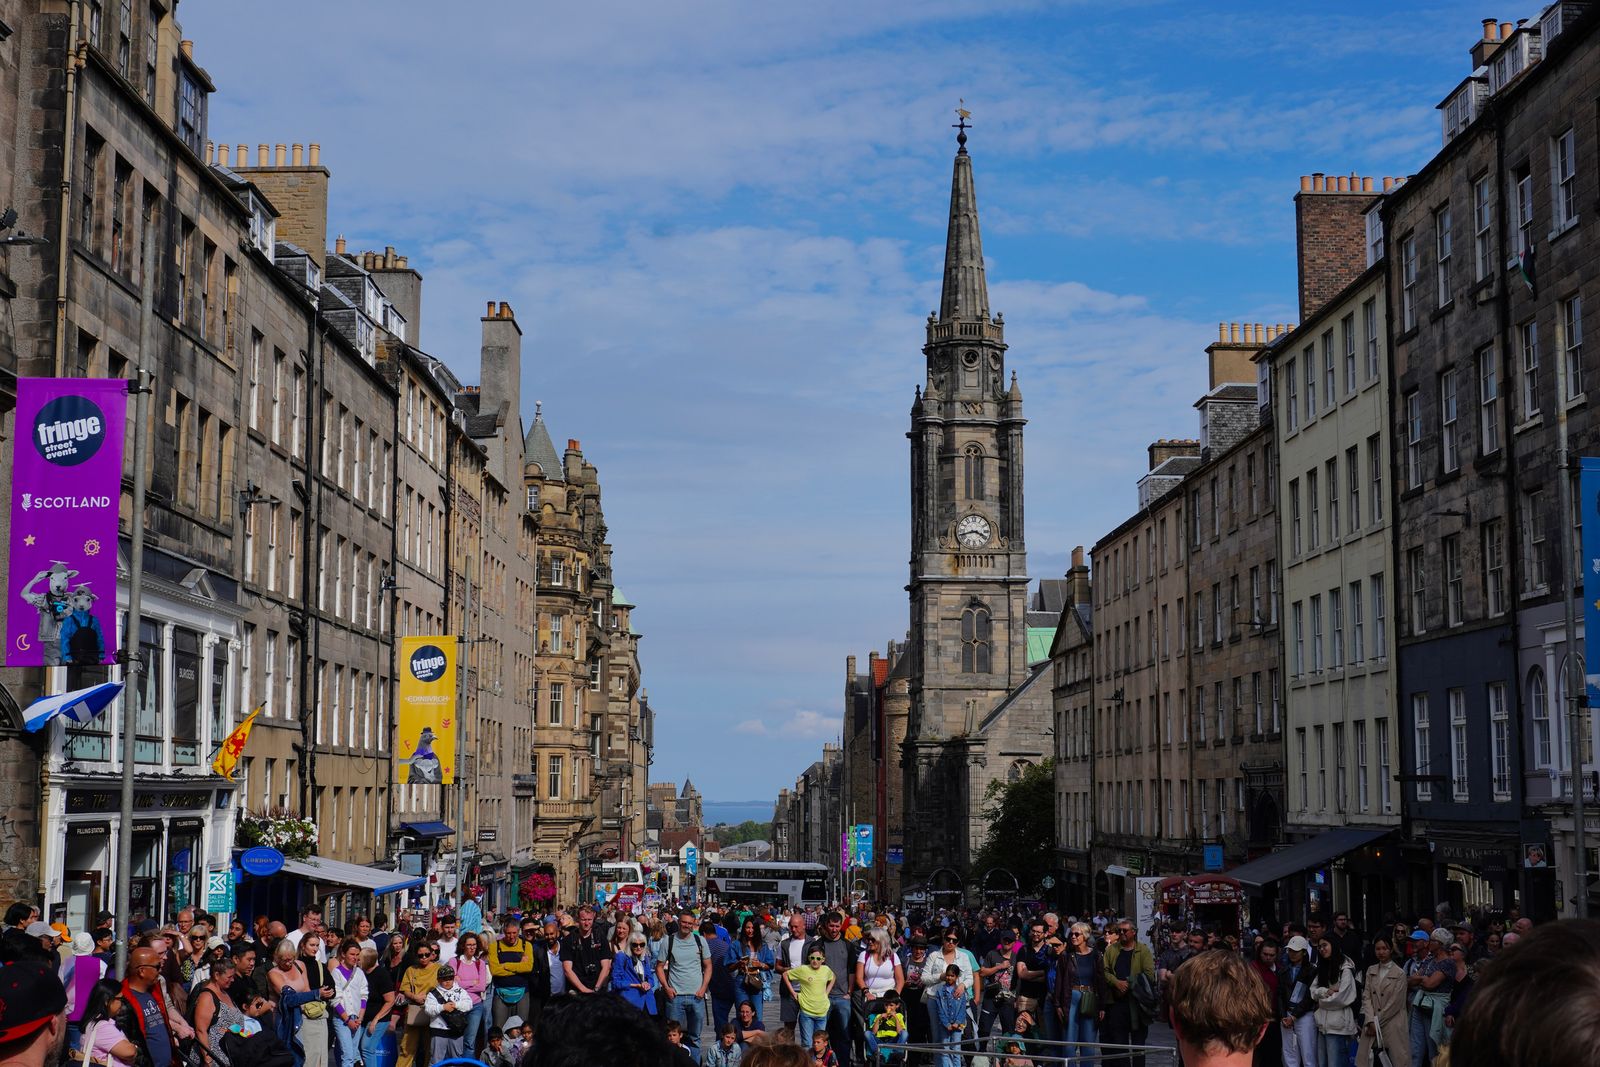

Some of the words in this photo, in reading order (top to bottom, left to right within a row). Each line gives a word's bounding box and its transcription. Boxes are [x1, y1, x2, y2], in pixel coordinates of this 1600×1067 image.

[38, 416, 101, 446] fringe
[45, 440, 73, 452] street
[46, 447, 78, 460] events
[34, 496, 110, 508] SCOTLAND
[412, 655, 445, 672] fringe
